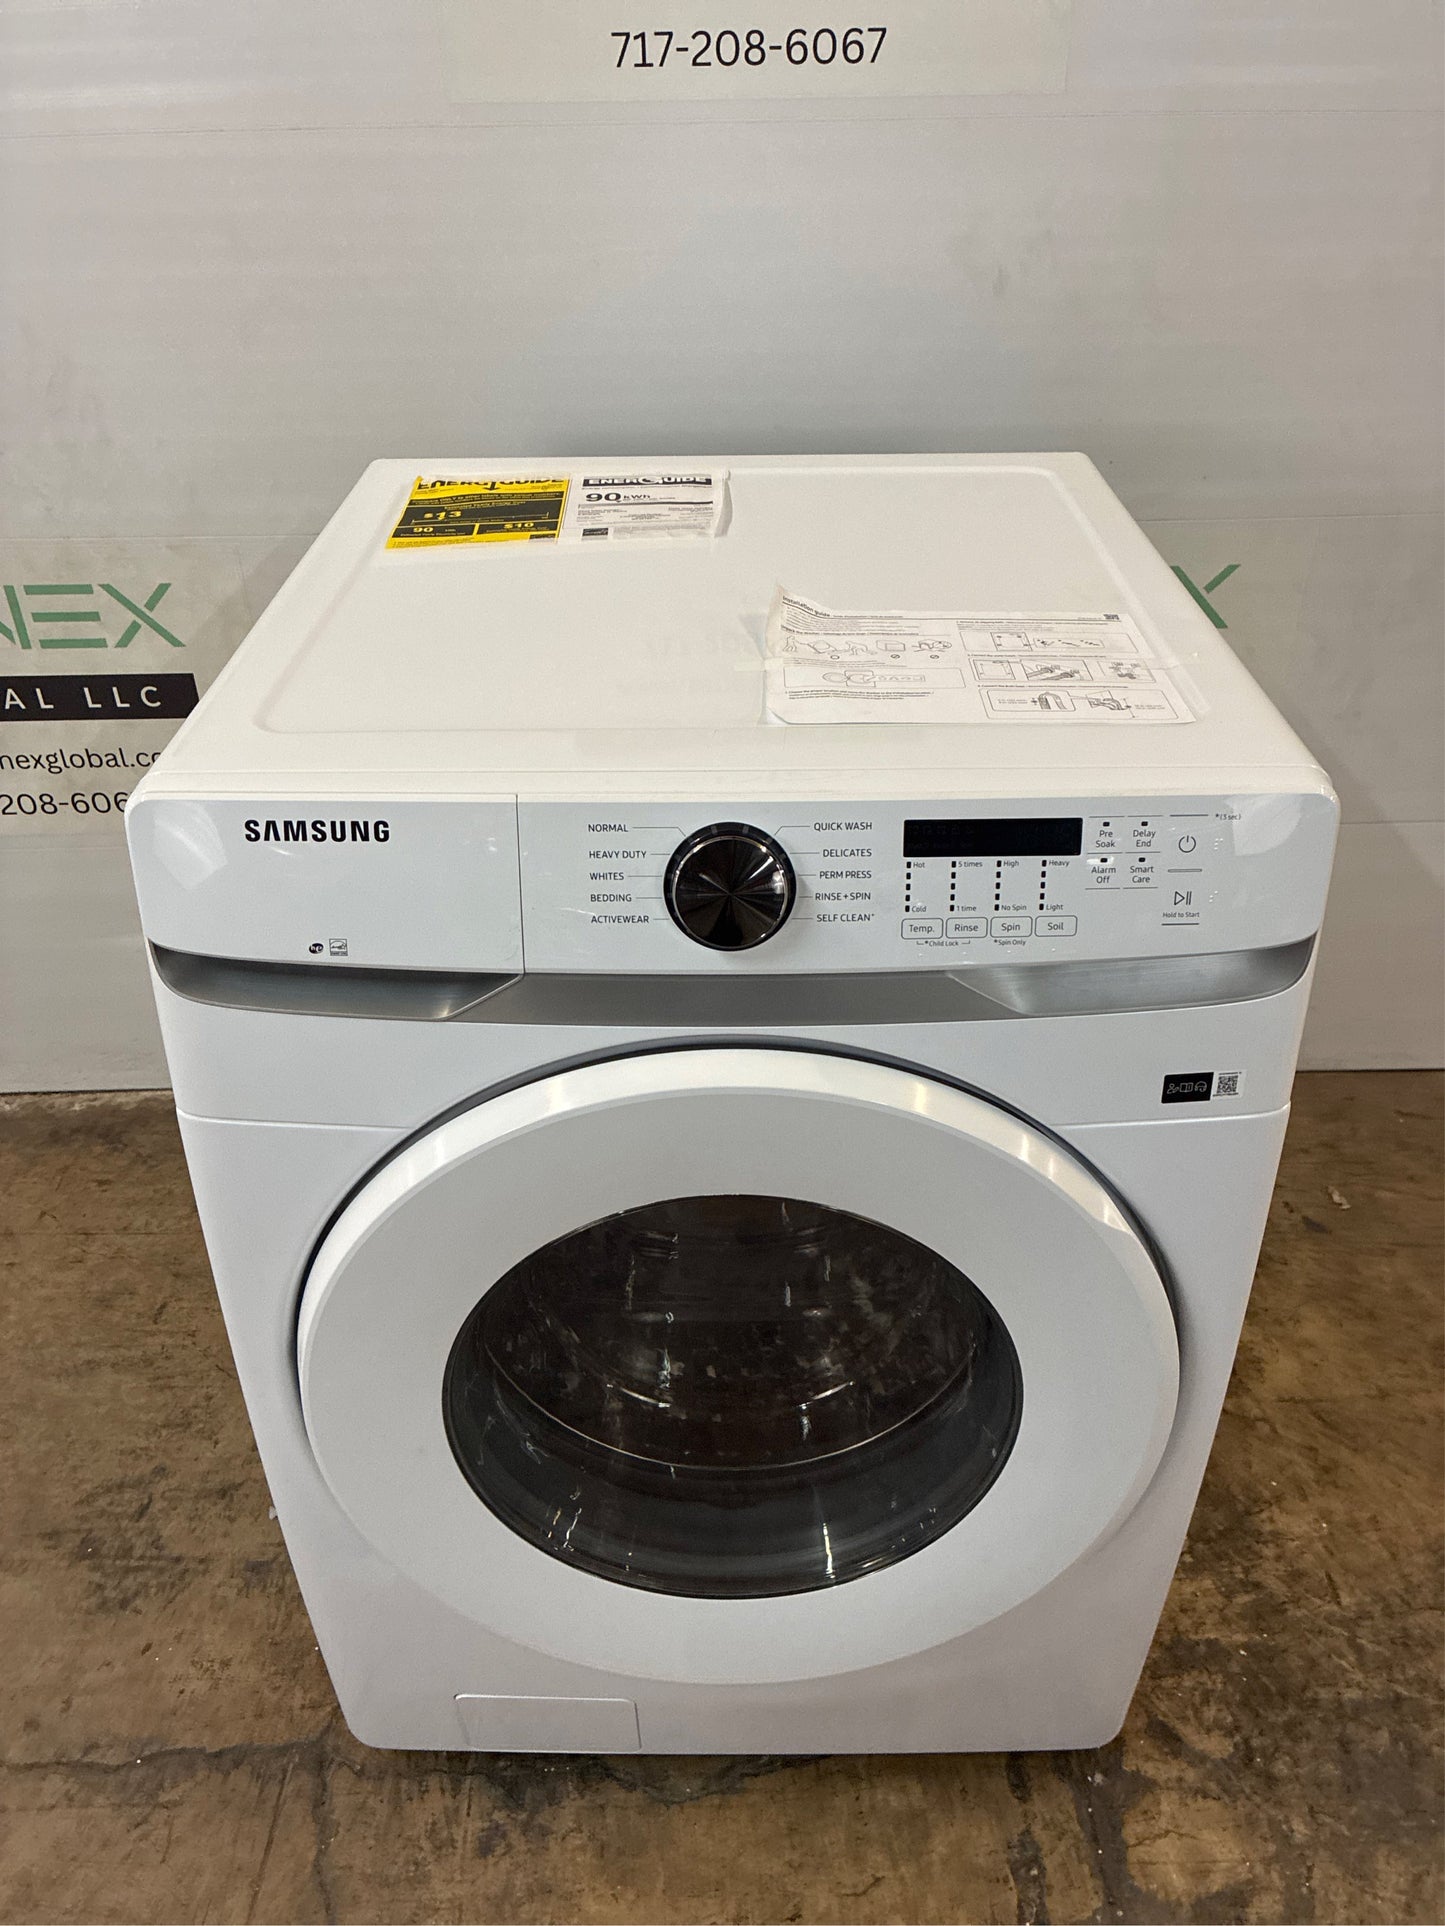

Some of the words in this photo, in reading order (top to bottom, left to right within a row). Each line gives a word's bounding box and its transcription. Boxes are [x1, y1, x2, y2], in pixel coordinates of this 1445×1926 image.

[611, 27, 888, 68] 717-208-6067
[586, 492, 622, 503] 90
[83, 686, 162, 708] LLC
[244, 820, 390, 842] SAMSUNG
[588, 824, 628, 833] NORMAL
[814, 822, 842, 831] QUICK
[844, 822, 872, 830] WASH
[1099, 830, 1113, 838] Pre
[1132, 829, 1156, 839] Delay
[1095, 840, 1115, 848] Soak
[1136, 839, 1151, 847] End
[589, 850, 620, 859] HEAVY
[622, 850, 647, 859] DUTY
[822, 849, 872, 857] DELICATES
[1003, 860, 1019, 868] High
[1091, 866, 1116, 874] Alarm
[1129, 865, 1154, 873] Smart
[590, 872, 624, 881] WHITES
[819, 871, 842, 879] PERM
[843, 870, 872, 879] PRESS
[1132, 875, 1151, 883] Care
[1096, 876, 1110, 884] Off
[590, 894, 632, 903] BEDDING
[815, 892, 842, 901] RINSE
[850, 892, 871, 900] SPIN
[911, 905, 927, 913] Cold
[1012, 904, 1027, 912] Spin
[1046, 903, 1063, 911] Light
[591, 915, 649, 924] ACTIVEWEAR
[816, 914, 838, 922] SELF
[909, 924, 935, 934] Temp.
[954, 923, 979, 932] Rinse
[1001, 923, 1021, 933] Spin
[1047, 922, 1064, 931] Soil
